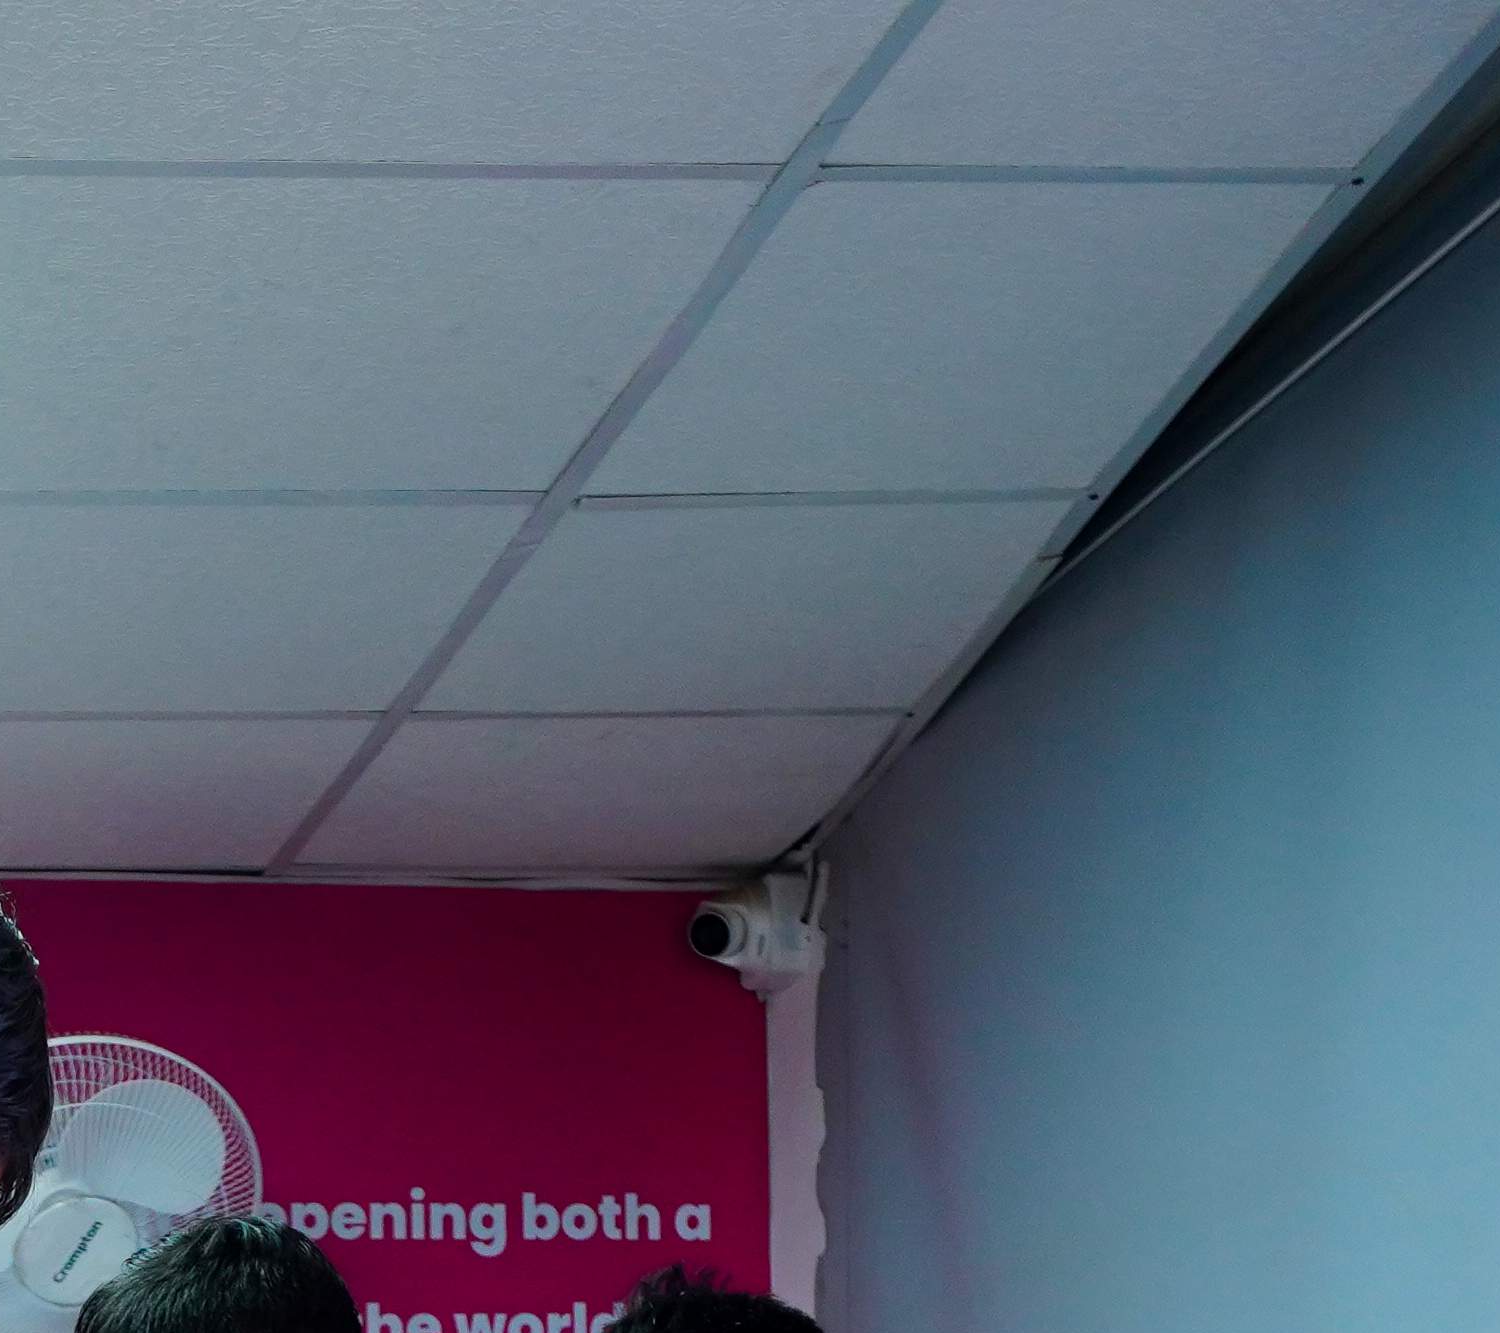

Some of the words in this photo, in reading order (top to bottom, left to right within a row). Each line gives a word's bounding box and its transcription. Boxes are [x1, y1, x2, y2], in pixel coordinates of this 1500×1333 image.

[521, 1192, 662, 1242] both
[674, 1203, 711, 1242] a
[53, 1221, 103, 1284] Crompton
